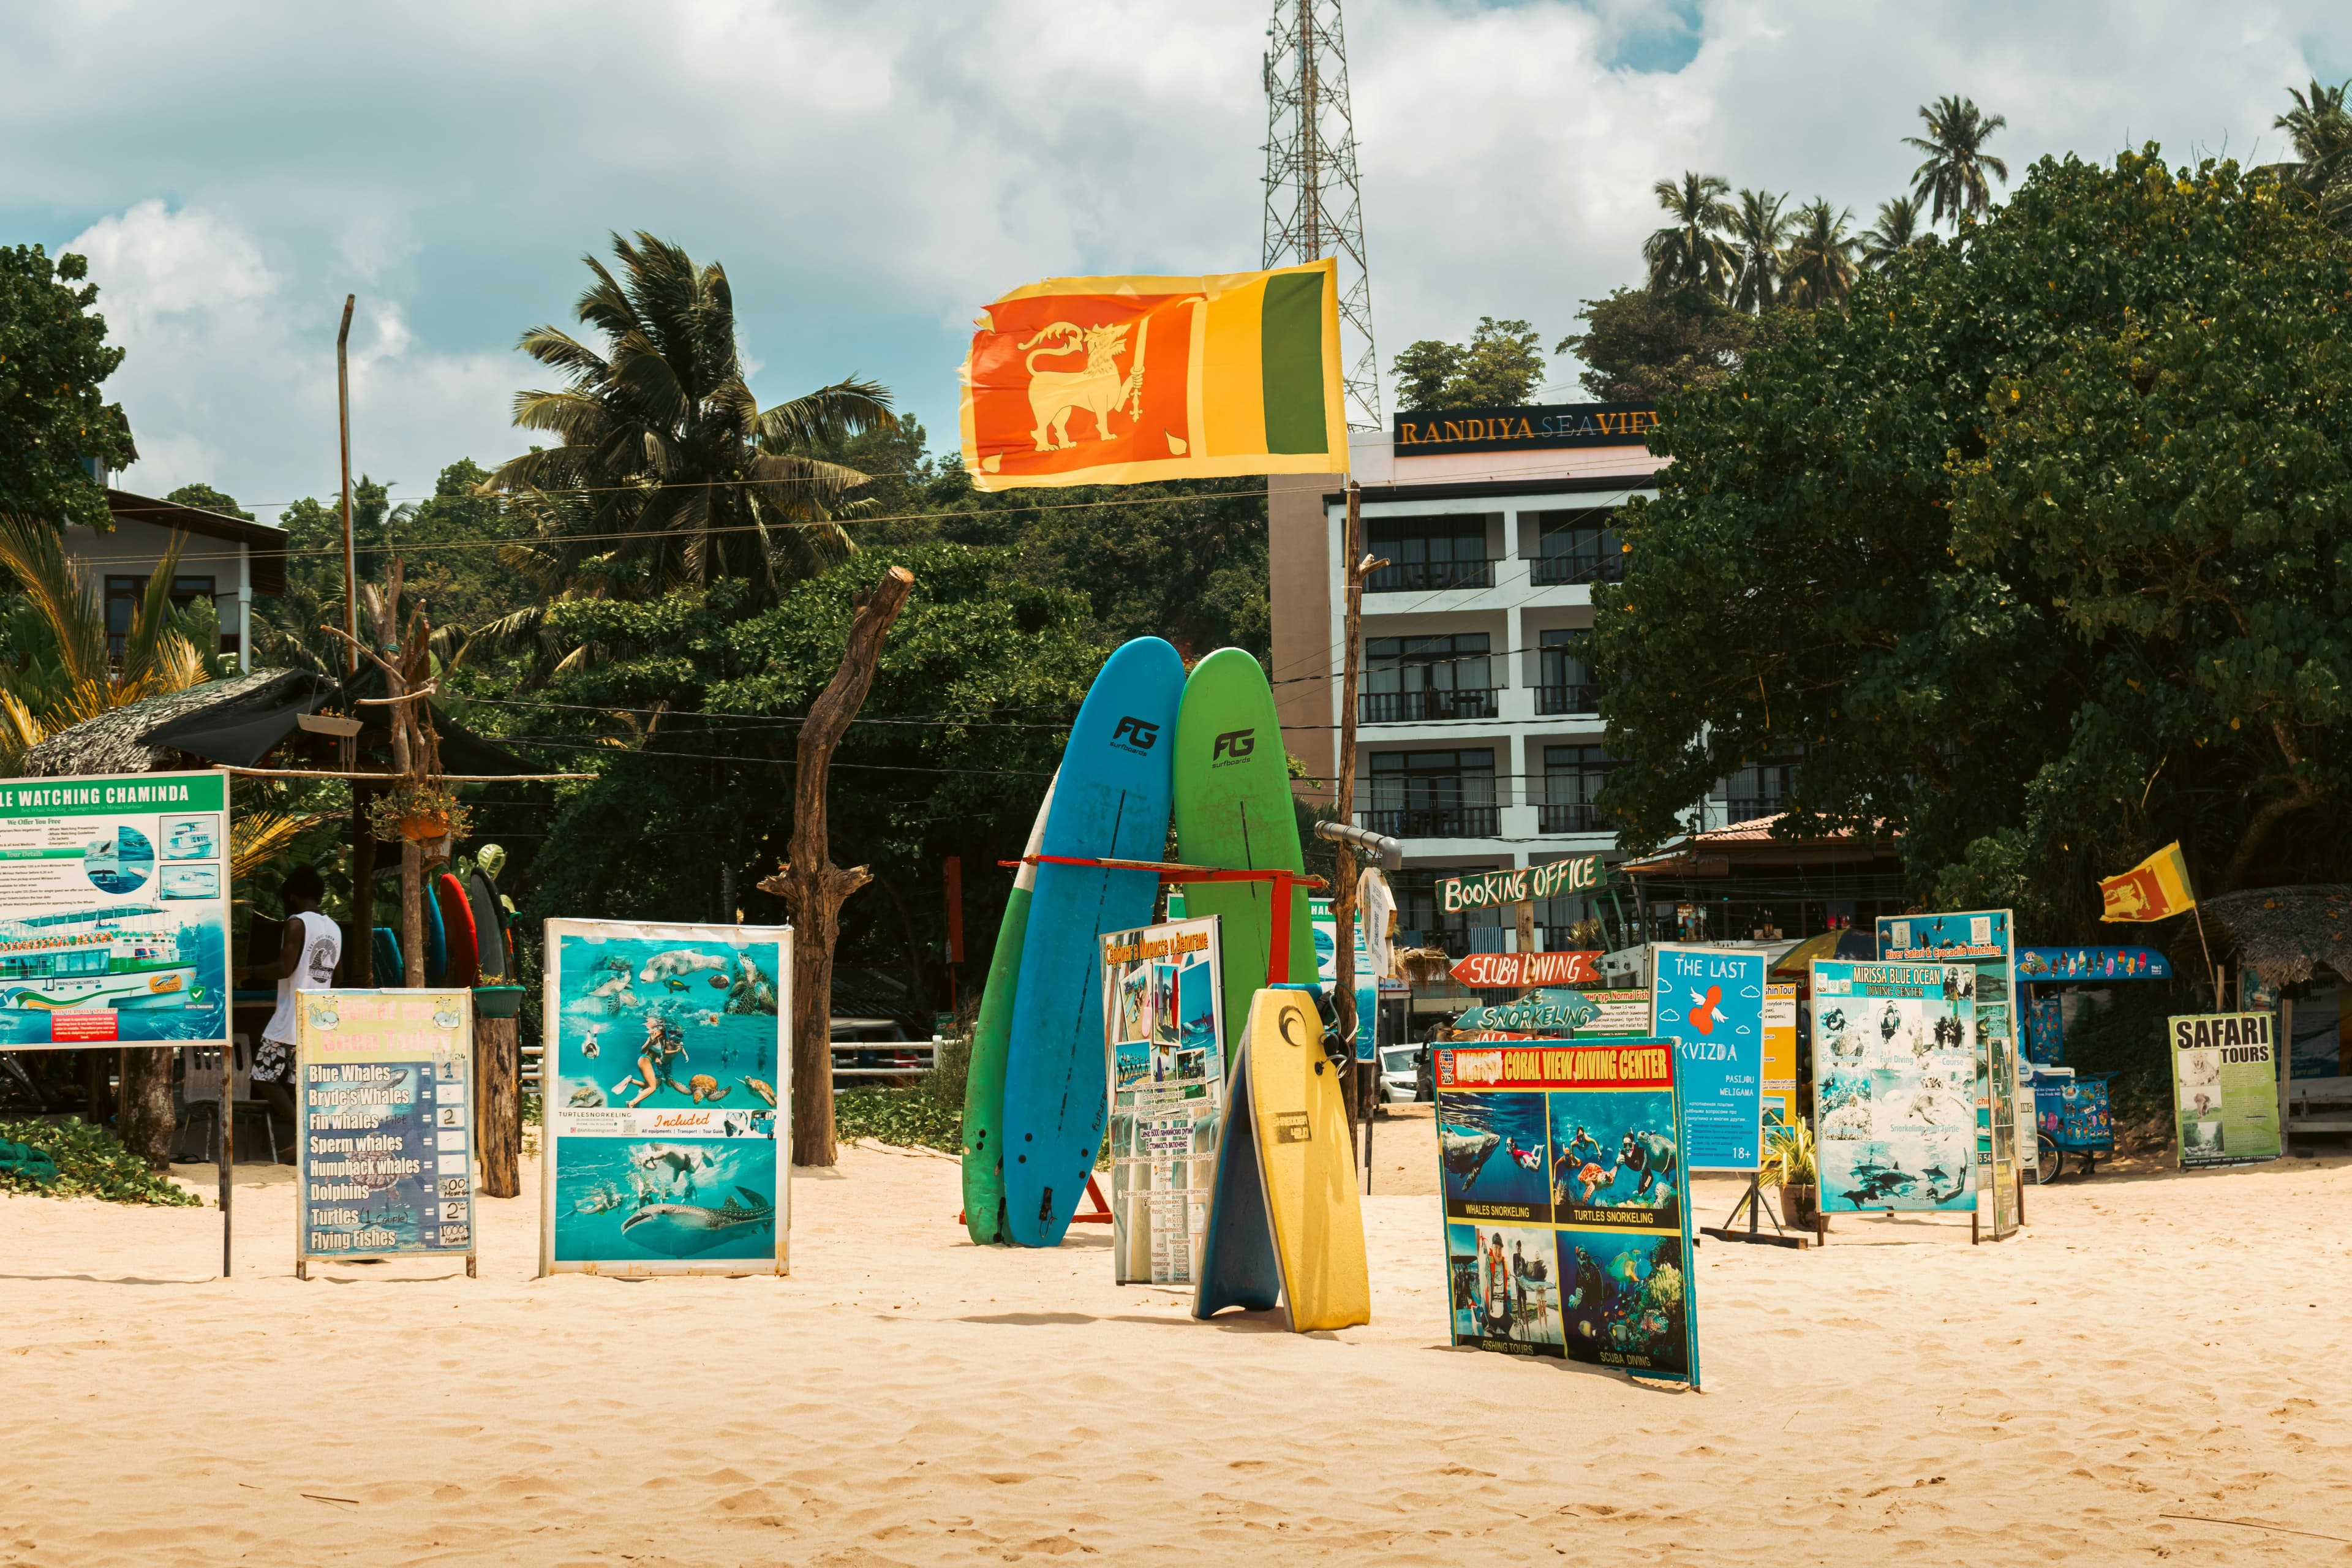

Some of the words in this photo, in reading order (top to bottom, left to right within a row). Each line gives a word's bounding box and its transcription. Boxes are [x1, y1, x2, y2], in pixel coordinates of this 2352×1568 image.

[1400, 417, 1534, 445] RANDIYA
[1112, 715, 1160, 749] FG
[1109, 741, 1147, 757] surfboards
[1213, 728, 1255, 761] FG
[1212, 756, 1251, 769] surfboards
[18, 788, 100, 807] WATCHING
[105, 785, 189, 804] CHAMINDA
[1444, 867, 1528, 913] BOOKING
[1533, 856, 1596, 897] OFFICE
[1139, 937, 1169, 963] Мириссе
[1170, 940, 1175, 955] и
[1175, 931, 1209, 954] Велигаме
[1885, 950, 1903, 959] River
[1904, 949, 1926, 958] Safari
[1926, 949, 1932, 957] &
[1933, 946, 1967, 958] Crocadile
[1967, 945, 2000, 956] Watching
[1470, 956, 1520, 985] SCUBA
[1525, 952, 1580, 983] DIVING
[1675, 958, 1703, 976] THE
[1709, 961, 1747, 979] LAST
[1853, 967, 1887, 984] MIRISSA
[1889, 968, 1912, 984] BLUE
[1913, 968, 1940, 986] OCEAN
[1597, 993, 1611, 1003] тур.
[1611, 991, 1635, 1000] Normal
[1779, 986, 1795, 995] Tour
[1866, 986, 1893, 997] DIVING
[1894, 987, 1924, 998] CENTER
[337, 999, 397, 1020] What
[402, 1001, 434, 1020] we
[1477, 1005, 1593, 1030] SNORKELING
[322, 1030, 379, 1052] Seen
[383, 1029, 453, 1052] Today
[2176, 1016, 2268, 1049] SAFARI
[1822, 1054, 1843, 1063] Scuba
[1842, 1055, 1864, 1065] Diving
[1879, 1055, 1893, 1063] Fun
[1893, 1055, 1915, 1065] Diving
[2220, 1046, 2269, 1063] TOURS
[309, 1065, 339, 1083] Blue
[341, 1064, 391, 1082] Whales
[1441, 1074, 1454, 1084] PADI
[1505, 1050, 1542, 1082] CORAL
[1542, 1050, 1575, 1082] VIEW
[1575, 1049, 1618, 1081] DIVING
[1619, 1048, 1668, 1080] CENTER
[309, 1088, 358, 1108] Bryde's
[360, 1087, 410, 1106] Whales
[1719, 1087, 1755, 1098] WELIGAMA
[309, 1112, 329, 1131] Fin
[331, 1111, 380, 1130] whales
[384, 1113, 407, 1125] Pilot
[443, 1109, 456, 1125] 2
[654, 1112, 710, 1128] Included
[1890, 1124, 1924, 1135] Snorkeling
[1940, 1125, 1960, 1133] Turtle
[309, 1135, 354, 1155] Sperm
[355, 1133, 404, 1152] whales
[1733, 1147, 1752, 1159] 18+
[309, 1158, 375, 1178] Humpback
[376, 1156, 420, 1175] whales
[311, 1182, 370, 1202] Dolphins
[311, 1207, 360, 1226] Turtles
[447, 1202, 459, 1219] 2
[1465, 1204, 1490, 1216] WHALES
[1491, 1205, 1530, 1218] SNORKELING
[1574, 1209, 1605, 1222] TURTLES
[1606, 1210, 1654, 1224] SNORKELING
[311, 1231, 351, 1251] Flying
[353, 1228, 396, 1248] Fishes
[1482, 1339, 1508, 1353] FISHING
[1509, 1342, 1534, 1355] TOURS
[1599, 1351, 1624, 1364] SCUBA
[1627, 1354, 1651, 1367] DIVING
